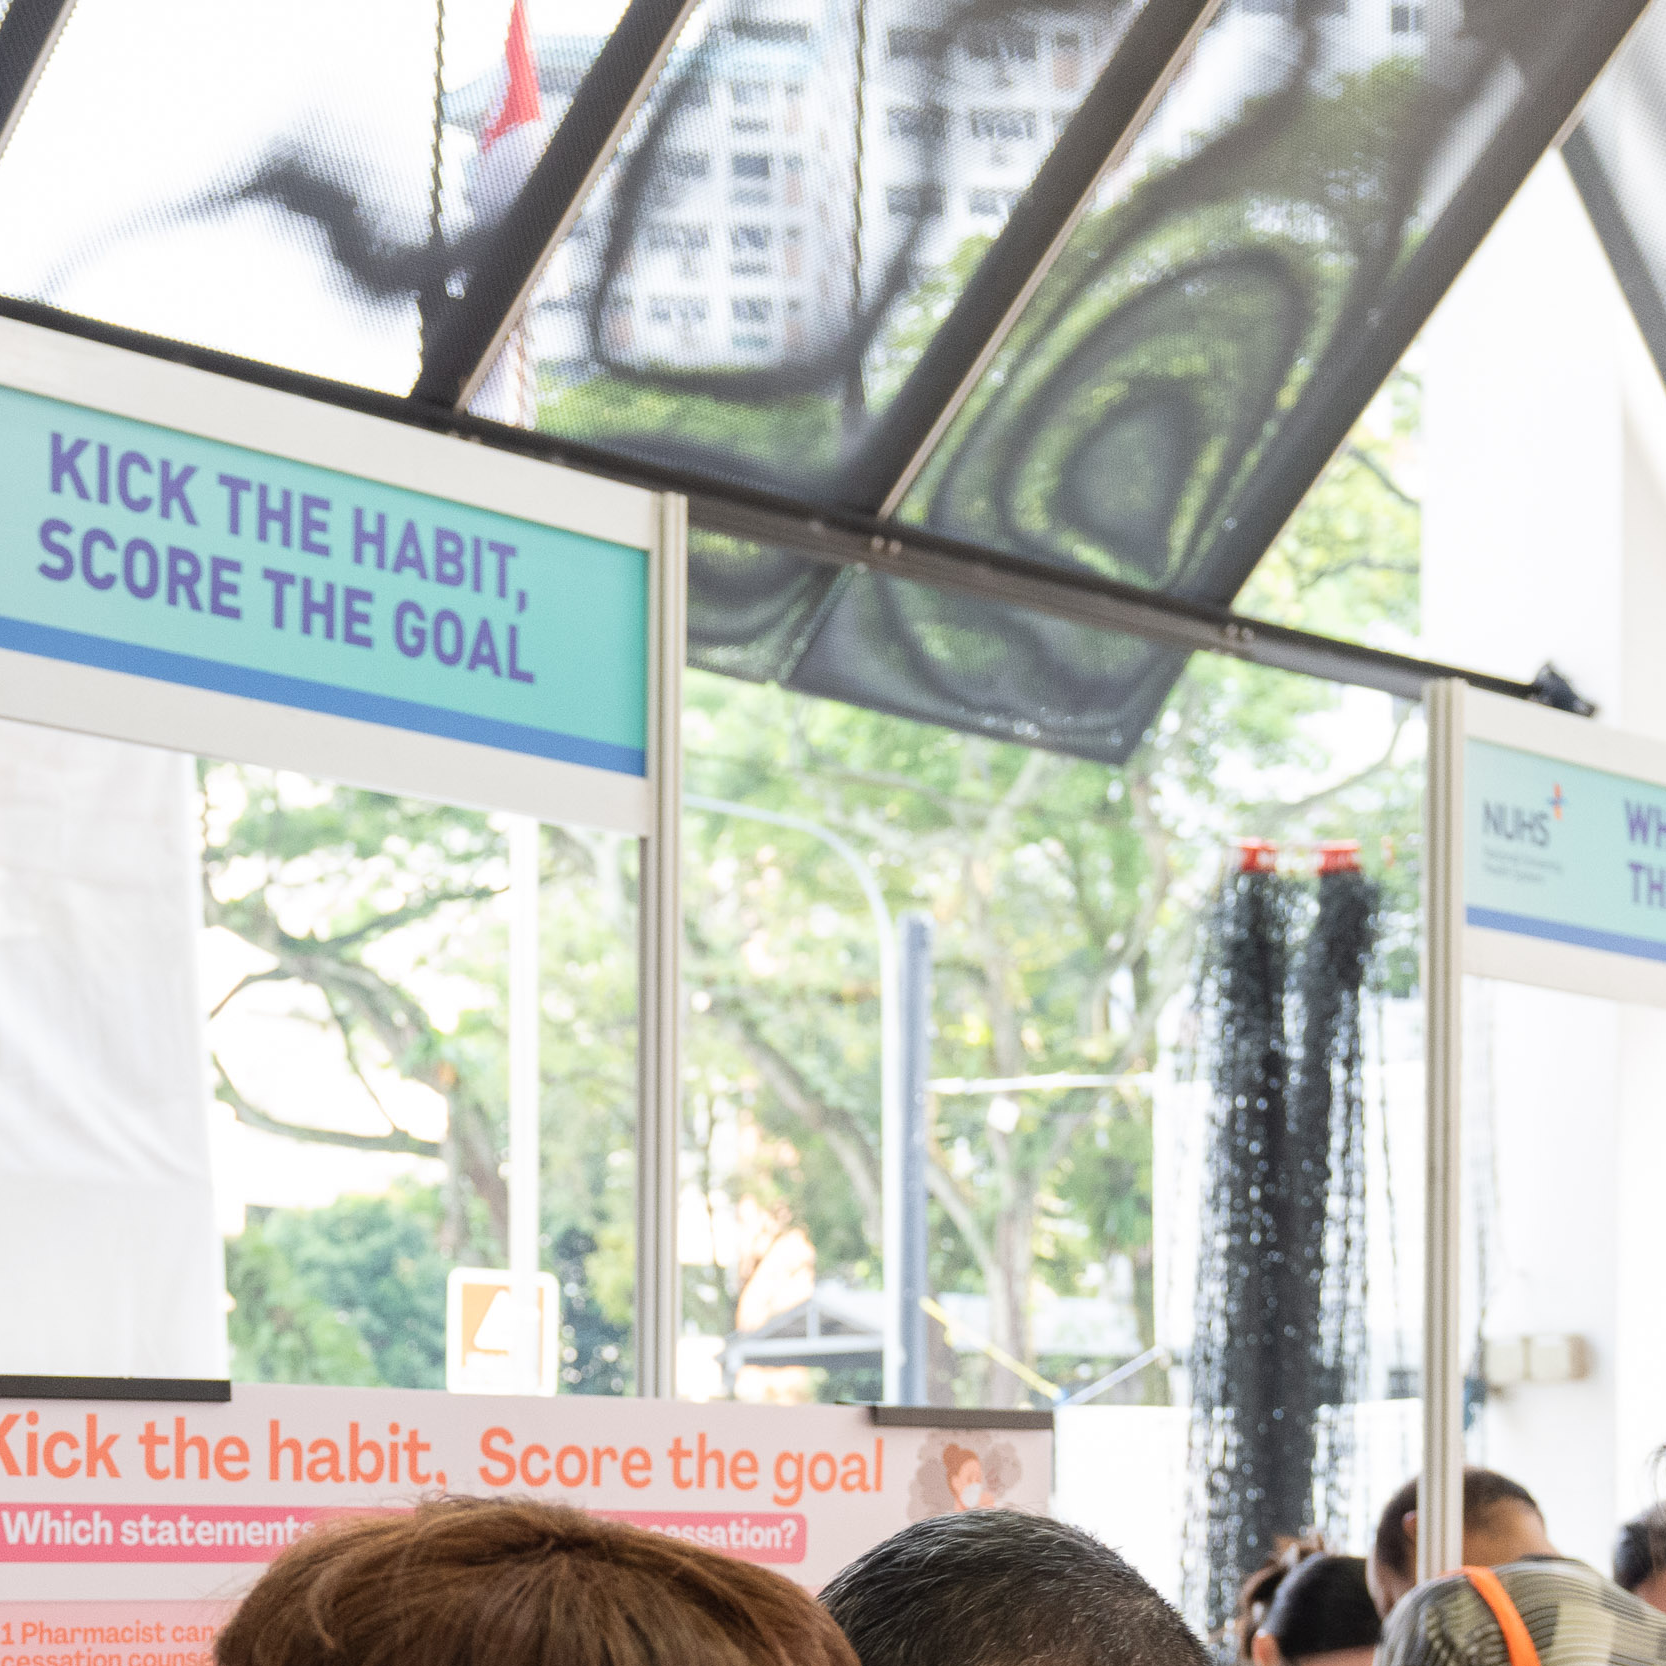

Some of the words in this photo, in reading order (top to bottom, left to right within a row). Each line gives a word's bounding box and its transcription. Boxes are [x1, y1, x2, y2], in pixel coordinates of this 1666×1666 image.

[49, 432, 197, 525] KICK
[218, 473, 330, 558] THE
[351, 508, 529, 615] HABIT,
[38, 518, 242, 619] SCORE
[262, 567, 372, 648] THE
[393, 600, 535, 683] GOAL
[1482, 799, 1550, 848] NUHS
[138, 1416, 250, 1480] the
[478, 1427, 653, 1488] Score
[668, 1433, 759, 1490] the
[773, 1437, 884, 1507] goal
[1, 1510, 113, 1546] Which
[1, 1623, 14, 1646] 1
[21, 1621, 165, 1645] Pharmacist
[171, 1625, 214, 1643] can
